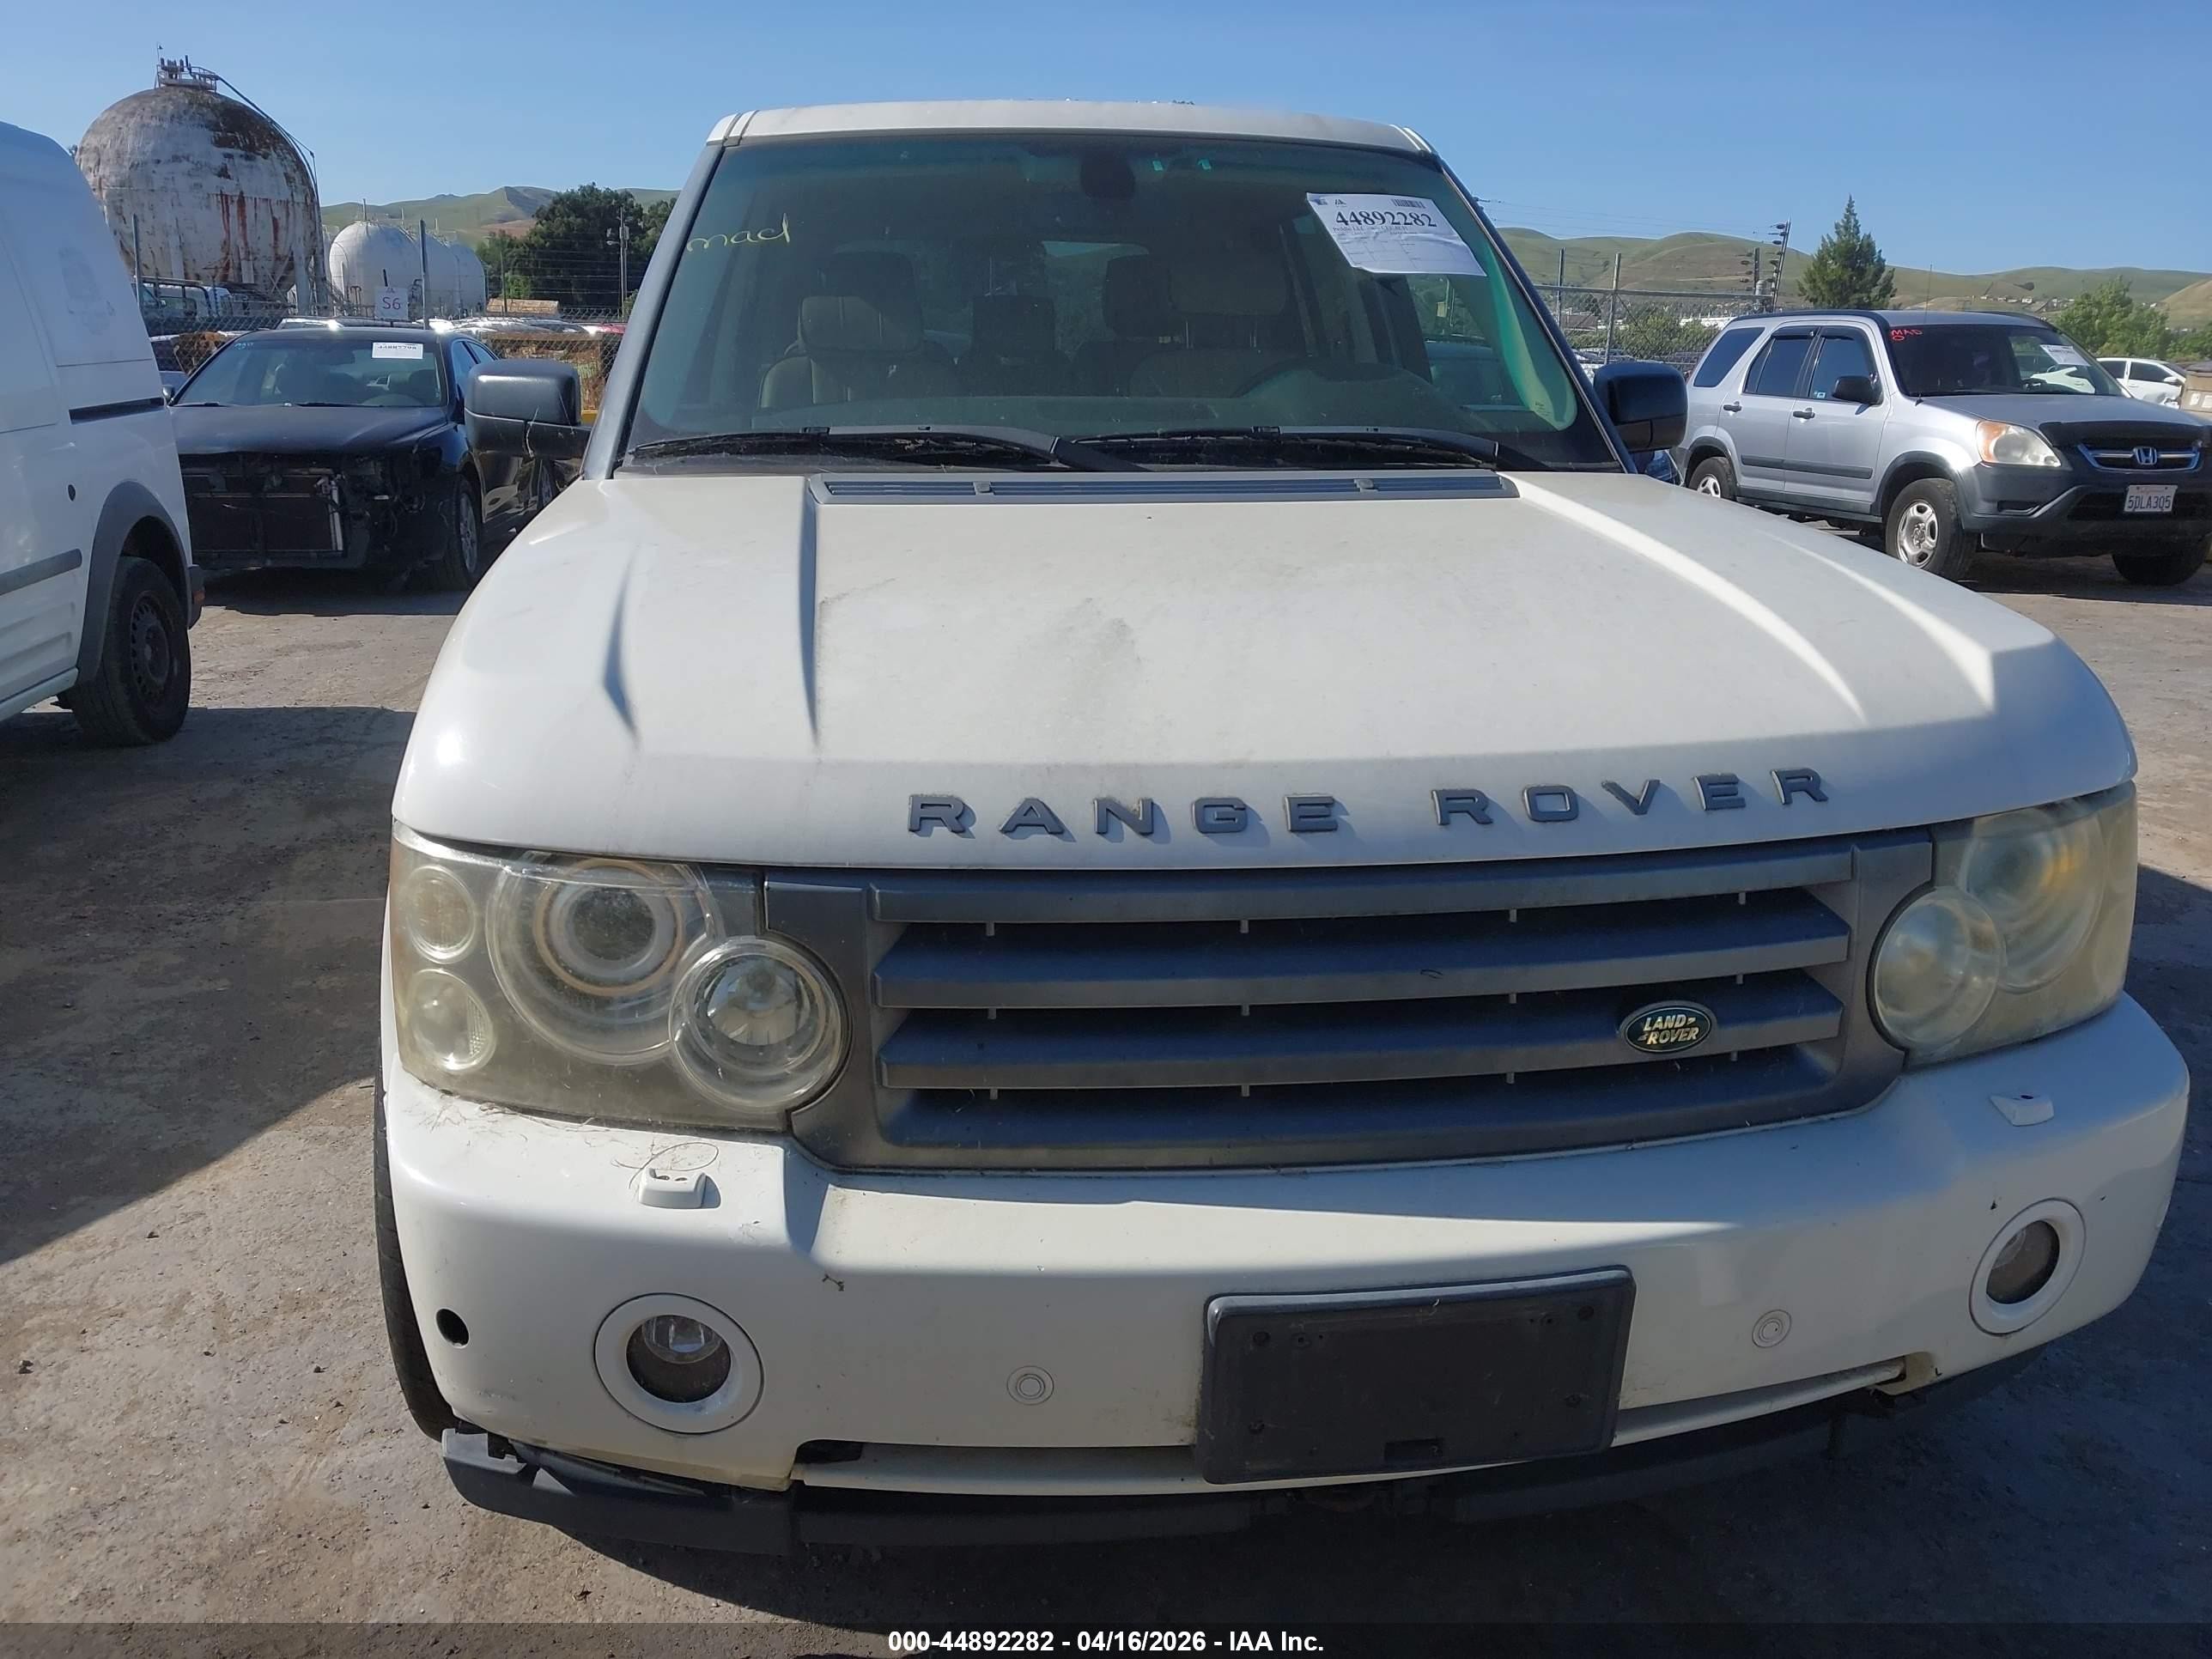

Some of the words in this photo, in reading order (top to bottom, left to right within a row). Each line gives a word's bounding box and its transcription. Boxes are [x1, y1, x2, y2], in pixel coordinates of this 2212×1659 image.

[1335, 210, 1437, 228] 44892282
[686, 213, 790, 252] mad
[382, 296, 401, 310] S6
[2128, 495, 2172, 509] 5DLA305
[908, 793, 1340, 836] RANGE
[1431, 767, 1829, 826] ROVER
[1646, 1027, 1699, 1045] ROVER
